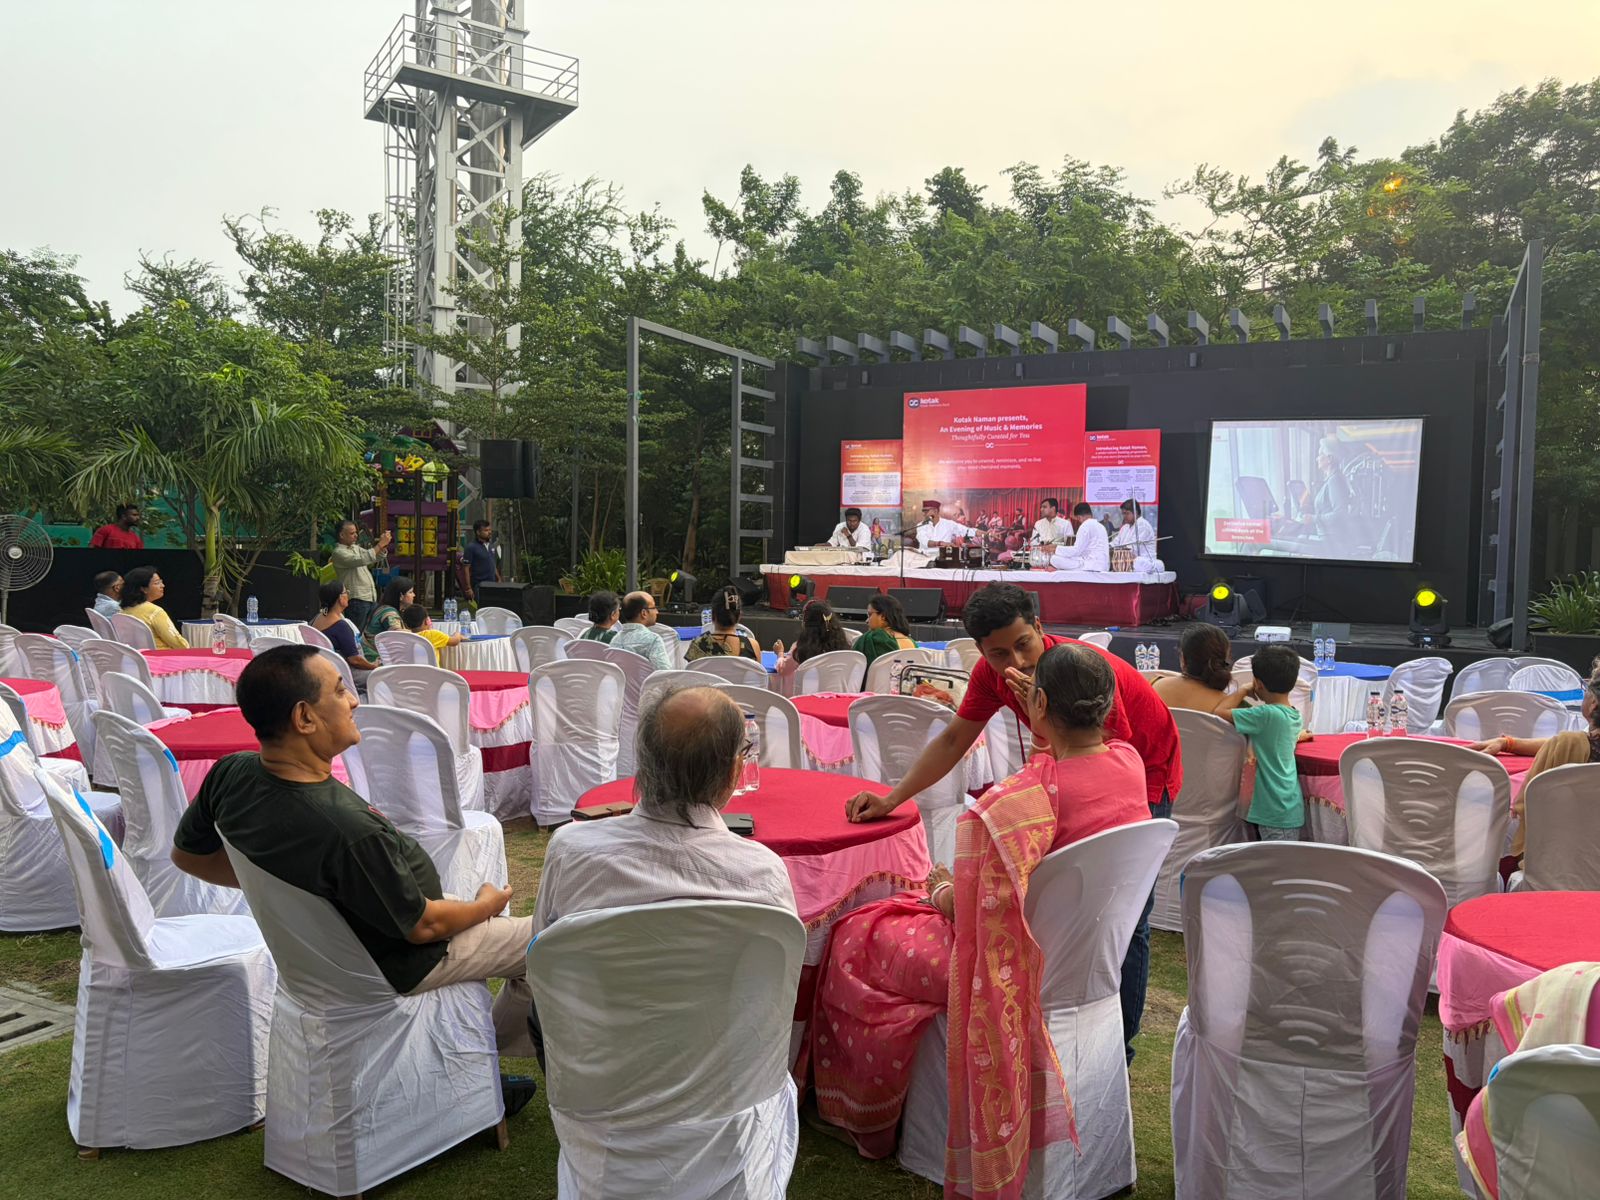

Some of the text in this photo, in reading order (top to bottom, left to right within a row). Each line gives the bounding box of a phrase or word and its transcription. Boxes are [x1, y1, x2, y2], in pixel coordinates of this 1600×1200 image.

[997, 415, 1028, 423] presents,
[950, 425, 975, 434] Evening
[1009, 423, 1043, 431] Memories
[951, 433, 986, 441] Thoughtfully
[1008, 433, 1018, 441] for
